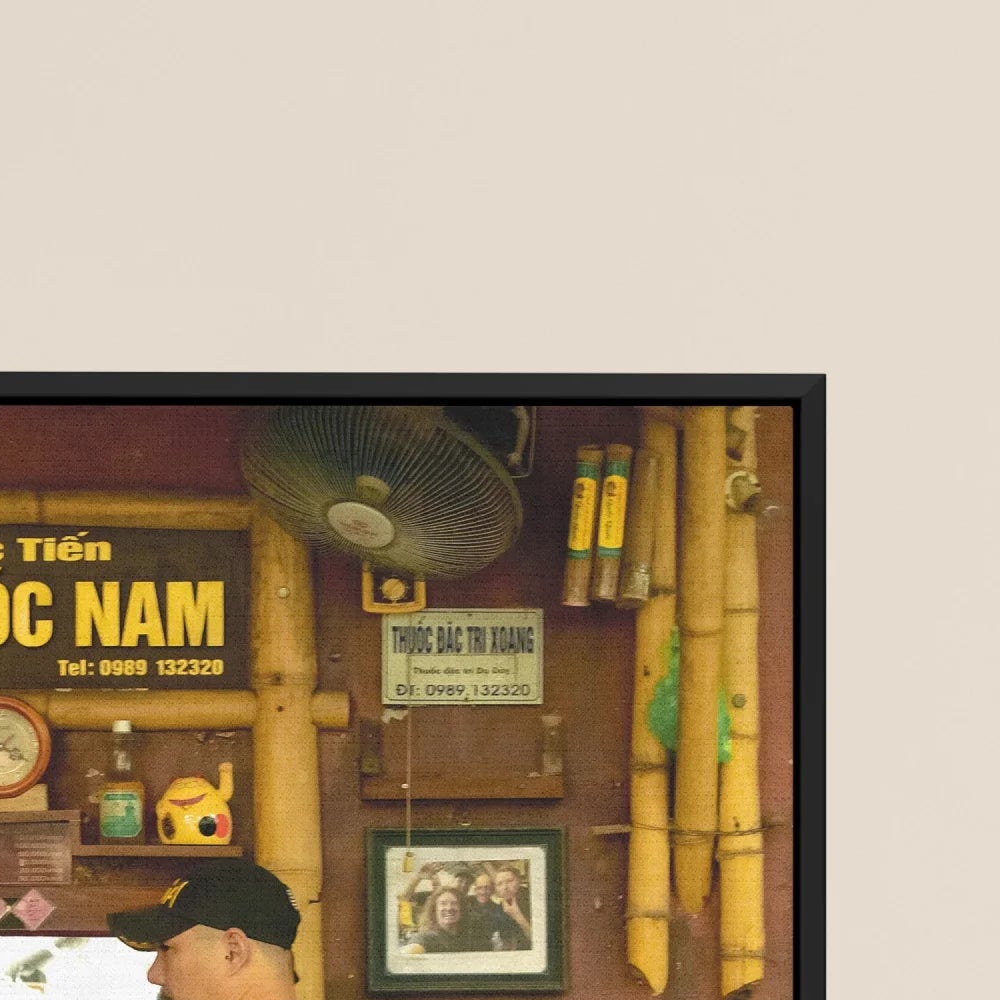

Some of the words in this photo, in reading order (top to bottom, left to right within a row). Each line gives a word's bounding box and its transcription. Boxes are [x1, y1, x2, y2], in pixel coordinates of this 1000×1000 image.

[16, 531, 112, 562] Tiến
[75, 580, 225, 647] NAM
[56, 659, 95, 676] Tel:
[99, 659, 148, 676] 0989
[155, 659, 225, 676] 132320
